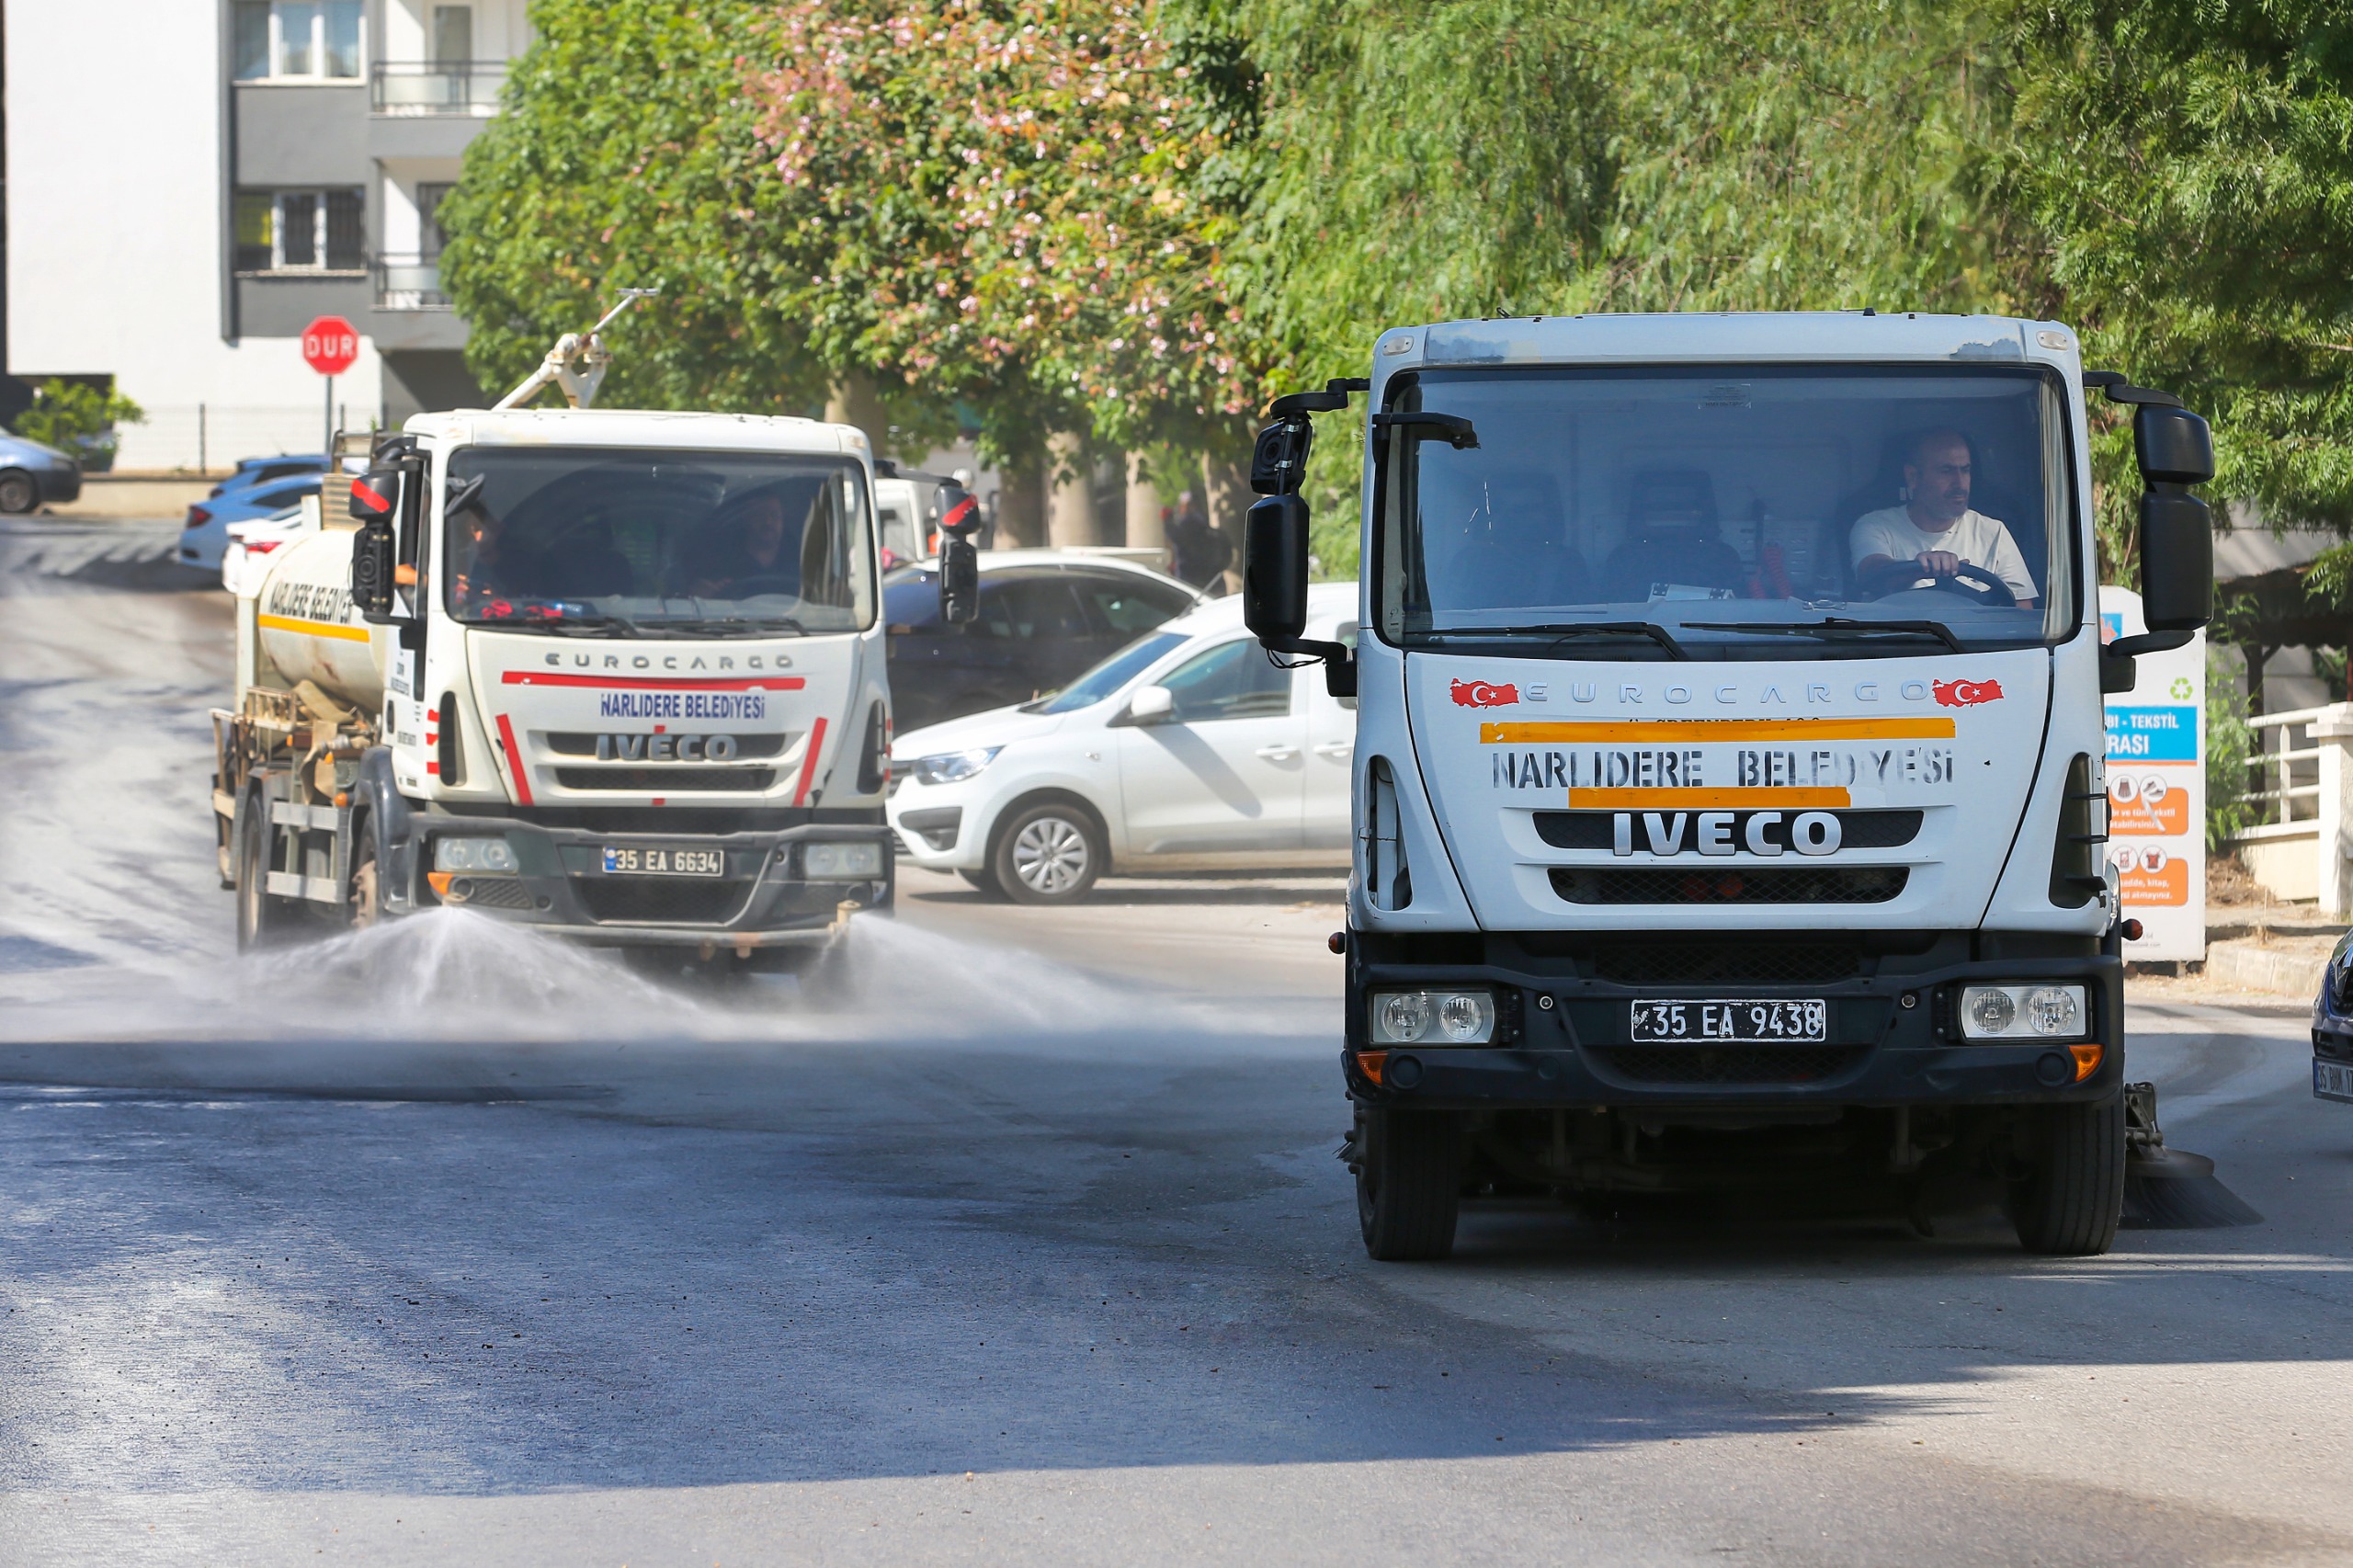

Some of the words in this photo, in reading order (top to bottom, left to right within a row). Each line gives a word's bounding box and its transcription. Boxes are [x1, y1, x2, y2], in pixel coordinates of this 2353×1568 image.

[307, 335, 354, 358] DUR
[545, 653, 794, 669] EUROCARGO
[1525, 680, 1929, 704] EUROCARGO
[601, 693, 680, 718] NARLIDERE
[596, 734, 738, 761] IVECO
[1493, 750, 1703, 789] NARLIDERE
[2154, 807, 2176, 817] ekstil
[1613, 812, 1843, 857] IVECO
[616, 849, 638, 869] 35
[645, 850, 667, 871] EA
[674, 851, 719, 872] 6634
[1652, 1006, 1687, 1036] 35
[1702, 1006, 1734, 1036] EA
[1750, 1006, 1821, 1036] 9438
